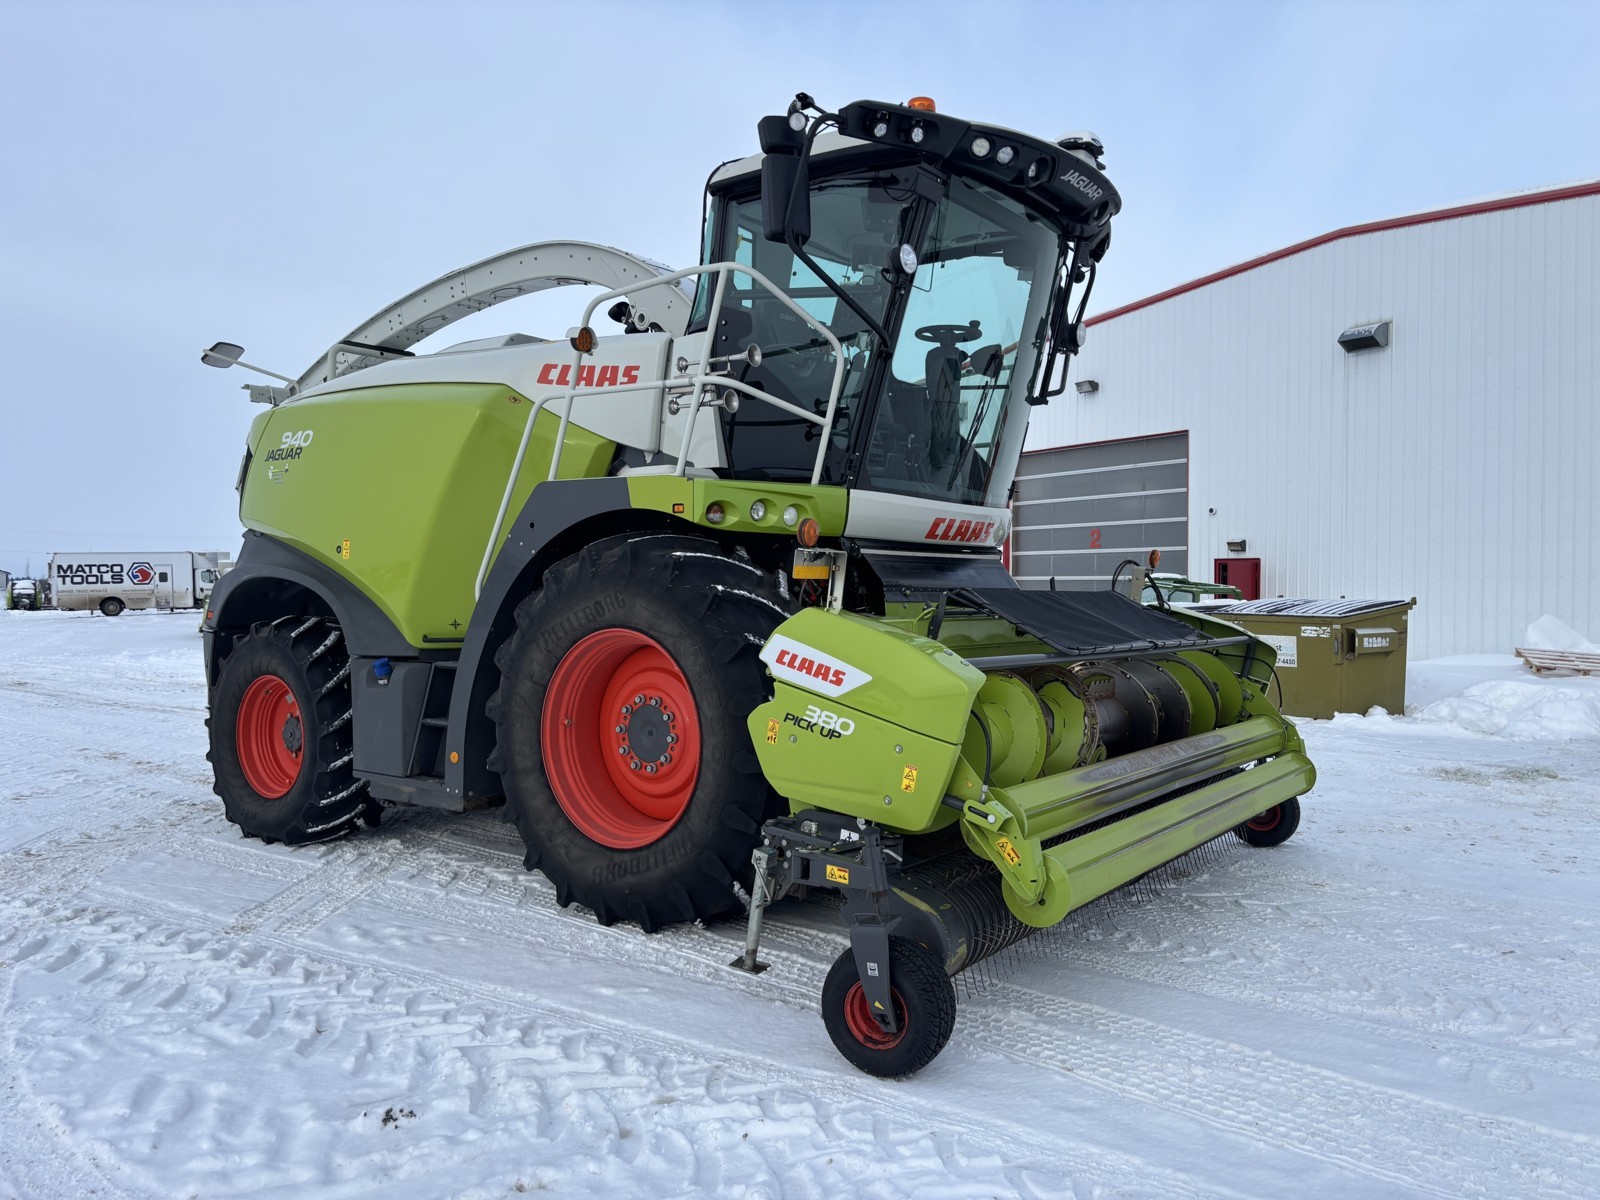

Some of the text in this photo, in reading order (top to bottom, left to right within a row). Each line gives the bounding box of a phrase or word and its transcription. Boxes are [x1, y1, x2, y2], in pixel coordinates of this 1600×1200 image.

[1060, 169, 1103, 201] JAGUAR
[536, 363, 640, 387] CLAAS
[280, 430, 314, 448] 940
[264, 447, 303, 462] JAGUAR
[924, 517, 995, 543] CLAAS
[1089, 528, 1101, 549] 2
[57, 564, 124, 575] MATCO
[57, 574, 124, 585] TOOLS
[775, 649, 846, 687] CLAAS
[783, 712, 842, 740] PICK UP
[803, 704, 855, 736] 380
